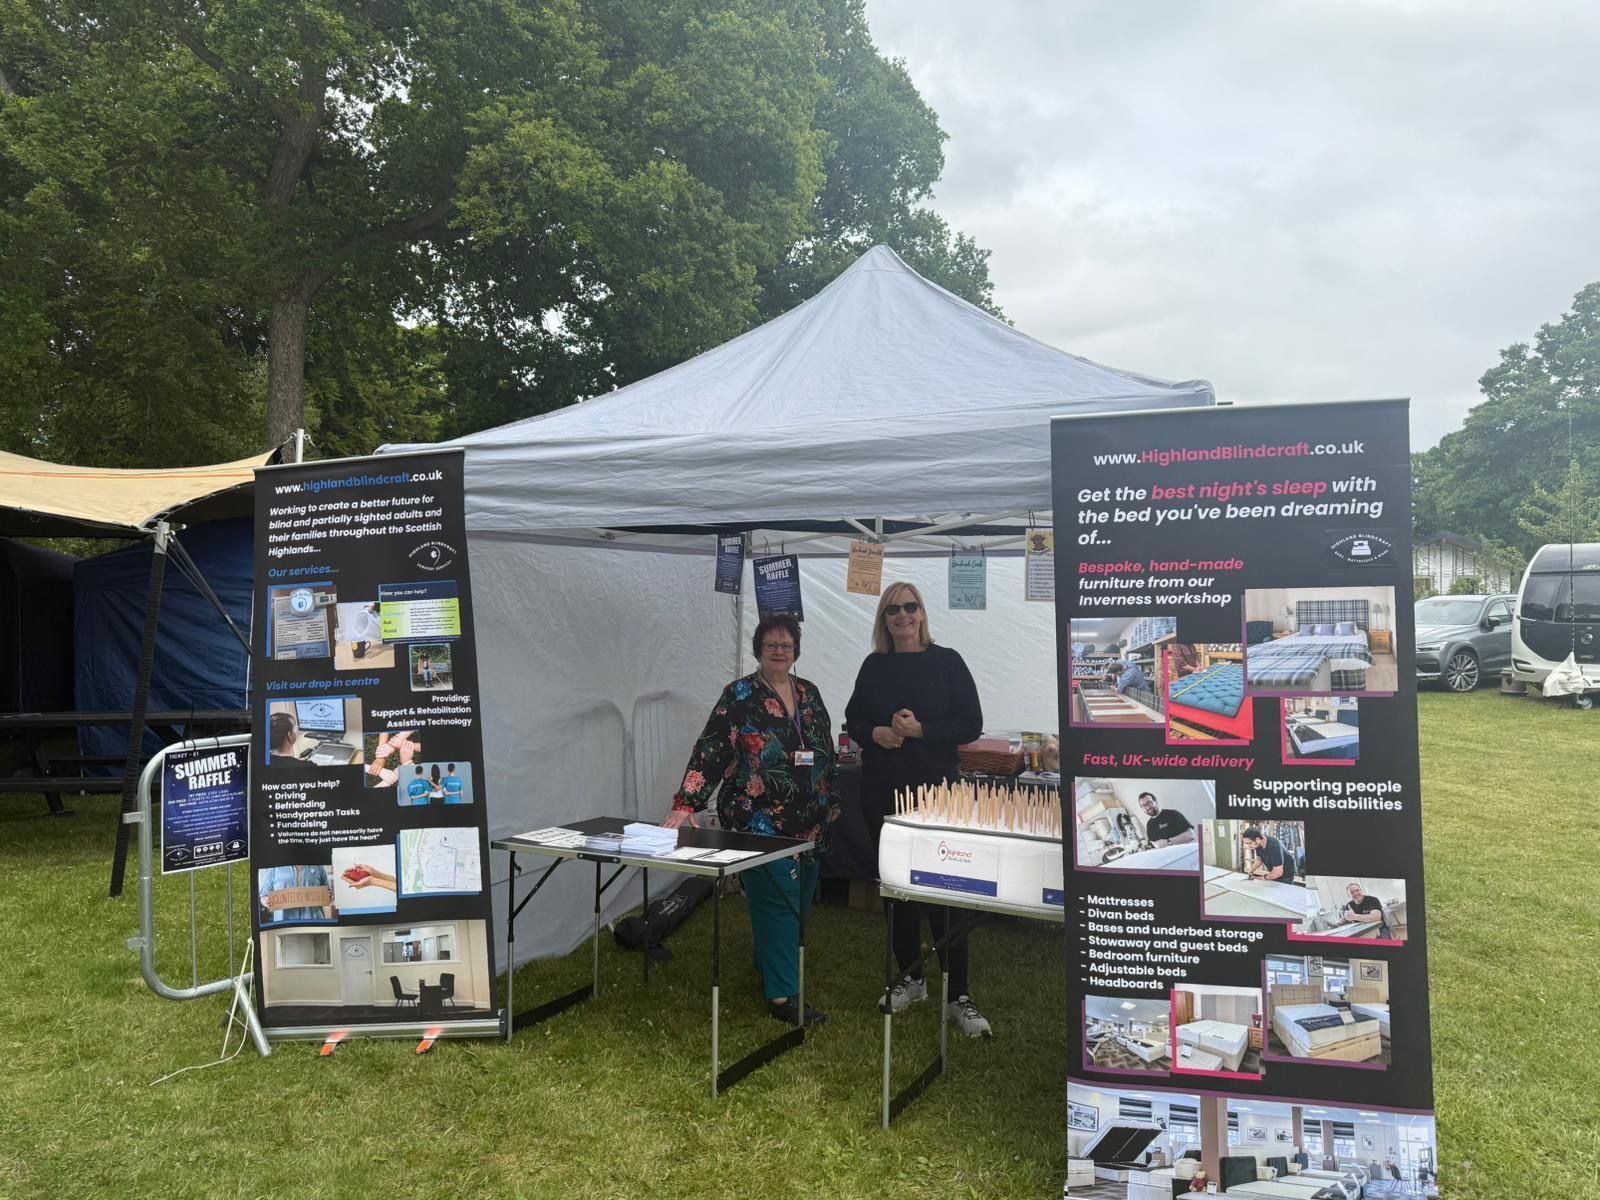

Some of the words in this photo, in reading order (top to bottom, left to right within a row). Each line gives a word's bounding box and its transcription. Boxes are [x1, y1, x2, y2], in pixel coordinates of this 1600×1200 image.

[1094, 440, 1364, 466] www.HighlandBlindcraft.co.uk
[275, 470, 442, 494] www.highlandblindcraft.co.uk
[1077, 488, 1112, 503] Get
[1115, 486, 1147, 501] the
[1151, 484, 1196, 500] best
[1199, 481, 1268, 503] night's
[1272, 479, 1327, 499] sleep
[1332, 476, 1377, 493] with
[270, 504, 307, 518] Working
[308, 504, 317, 513] to
[318, 501, 350, 512] create
[351, 502, 358, 510] a
[360, 498, 390, 508] better
[392, 496, 420, 507] future
[422, 495, 434, 504] for
[1078, 509, 1110, 524] the
[1114, 507, 1150, 523] bed
[1155, 504, 1222, 526] you've
[1226, 502, 1277, 519] been
[1280, 499, 1384, 518] dreaming
[269, 518, 291, 530] blind
[293, 517, 310, 528] and
[312, 513, 352, 528] partially
[354, 511, 392, 525] sighted
[394, 509, 423, 520] adults
[425, 508, 442, 518] and
[268, 532, 290, 544] their
[291, 529, 328, 542] families
[329, 526, 387, 540] throughout
[389, 525, 404, 534] the
[405, 522, 442, 534] Scottish
[1077, 530, 1112, 546] of...
[720, 536, 742, 546] SUMMER
[268, 544, 321, 558] Highlands...
[268, 567, 288, 578] Our
[289, 564, 340, 576] services...
[758, 558, 792, 575] SUMMER
[1078, 561, 1146, 578] Bespoke,
[1149, 558, 1244, 572] hand-made
[766, 570, 790, 580] RAFFLE
[1079, 578, 1145, 590] furniture
[1147, 576, 1185, 589] from
[1188, 577, 1214, 588] our
[1079, 594, 1152, 606] Inverness
[1155, 592, 1232, 608] workshop
[266, 681, 289, 692] Visit
[290, 681, 308, 690] our
[308, 679, 332, 692] drop
[332, 679, 344, 688] in
[345, 677, 380, 687] centre
[432, 694, 471, 704] Providing:
[371, 709, 408, 720] Support
[409, 708, 416, 716] &
[416, 706, 472, 716] Rehabilitation
[387, 718, 426, 729] Assistive
[427, 717, 472, 728] Technology
[170, 752, 188, 760] TICKET
[1083, 754, 1119, 768] Fast,
[1122, 754, 1188, 768] UK-wide
[1191, 755, 1255, 772] delivery
[174, 752, 237, 780] SUMMER
[188, 770, 232, 790] RAFFLE
[300, 782, 316, 791] you
[318, 780, 340, 790] help?
[1253, 779, 1343, 796] Supporting
[1346, 780, 1402, 796] people
[275, 792, 306, 800] Driving
[1228, 794, 1272, 812] living
[1274, 796, 1310, 810] with
[1312, 796, 1402, 811] disabilities
[275, 800, 326, 810] Befriending
[276, 810, 334, 820] Handyperson
[336, 808, 360, 816] Tasks
[277, 820, 328, 828] Fundraising
[278, 830, 310, 838] Volunteers
[331, 828, 366, 836] necessarily
[1087, 894, 1154, 908] Mattresses
[1088, 908, 1122, 920] Divan
[1125, 910, 1154, 921] beds
[1088, 922, 1124, 934] Bases
[1126, 923, 1150, 936] and
[1152, 924, 1212, 938] underbed
[1214, 928, 1264, 942] storage
[1088, 935, 1151, 950] Stowaway
[1153, 938, 1177, 950] and
[1179, 940, 1216, 954] guest
[1218, 941, 1248, 953] beds
[1088, 949, 1144, 962] Bedroom
[1146, 952, 1200, 964] furniture
[1089, 962, 1154, 978] Adjustable
[1156, 966, 1188, 978] beds
[1090, 976, 1164, 990] Headboards
